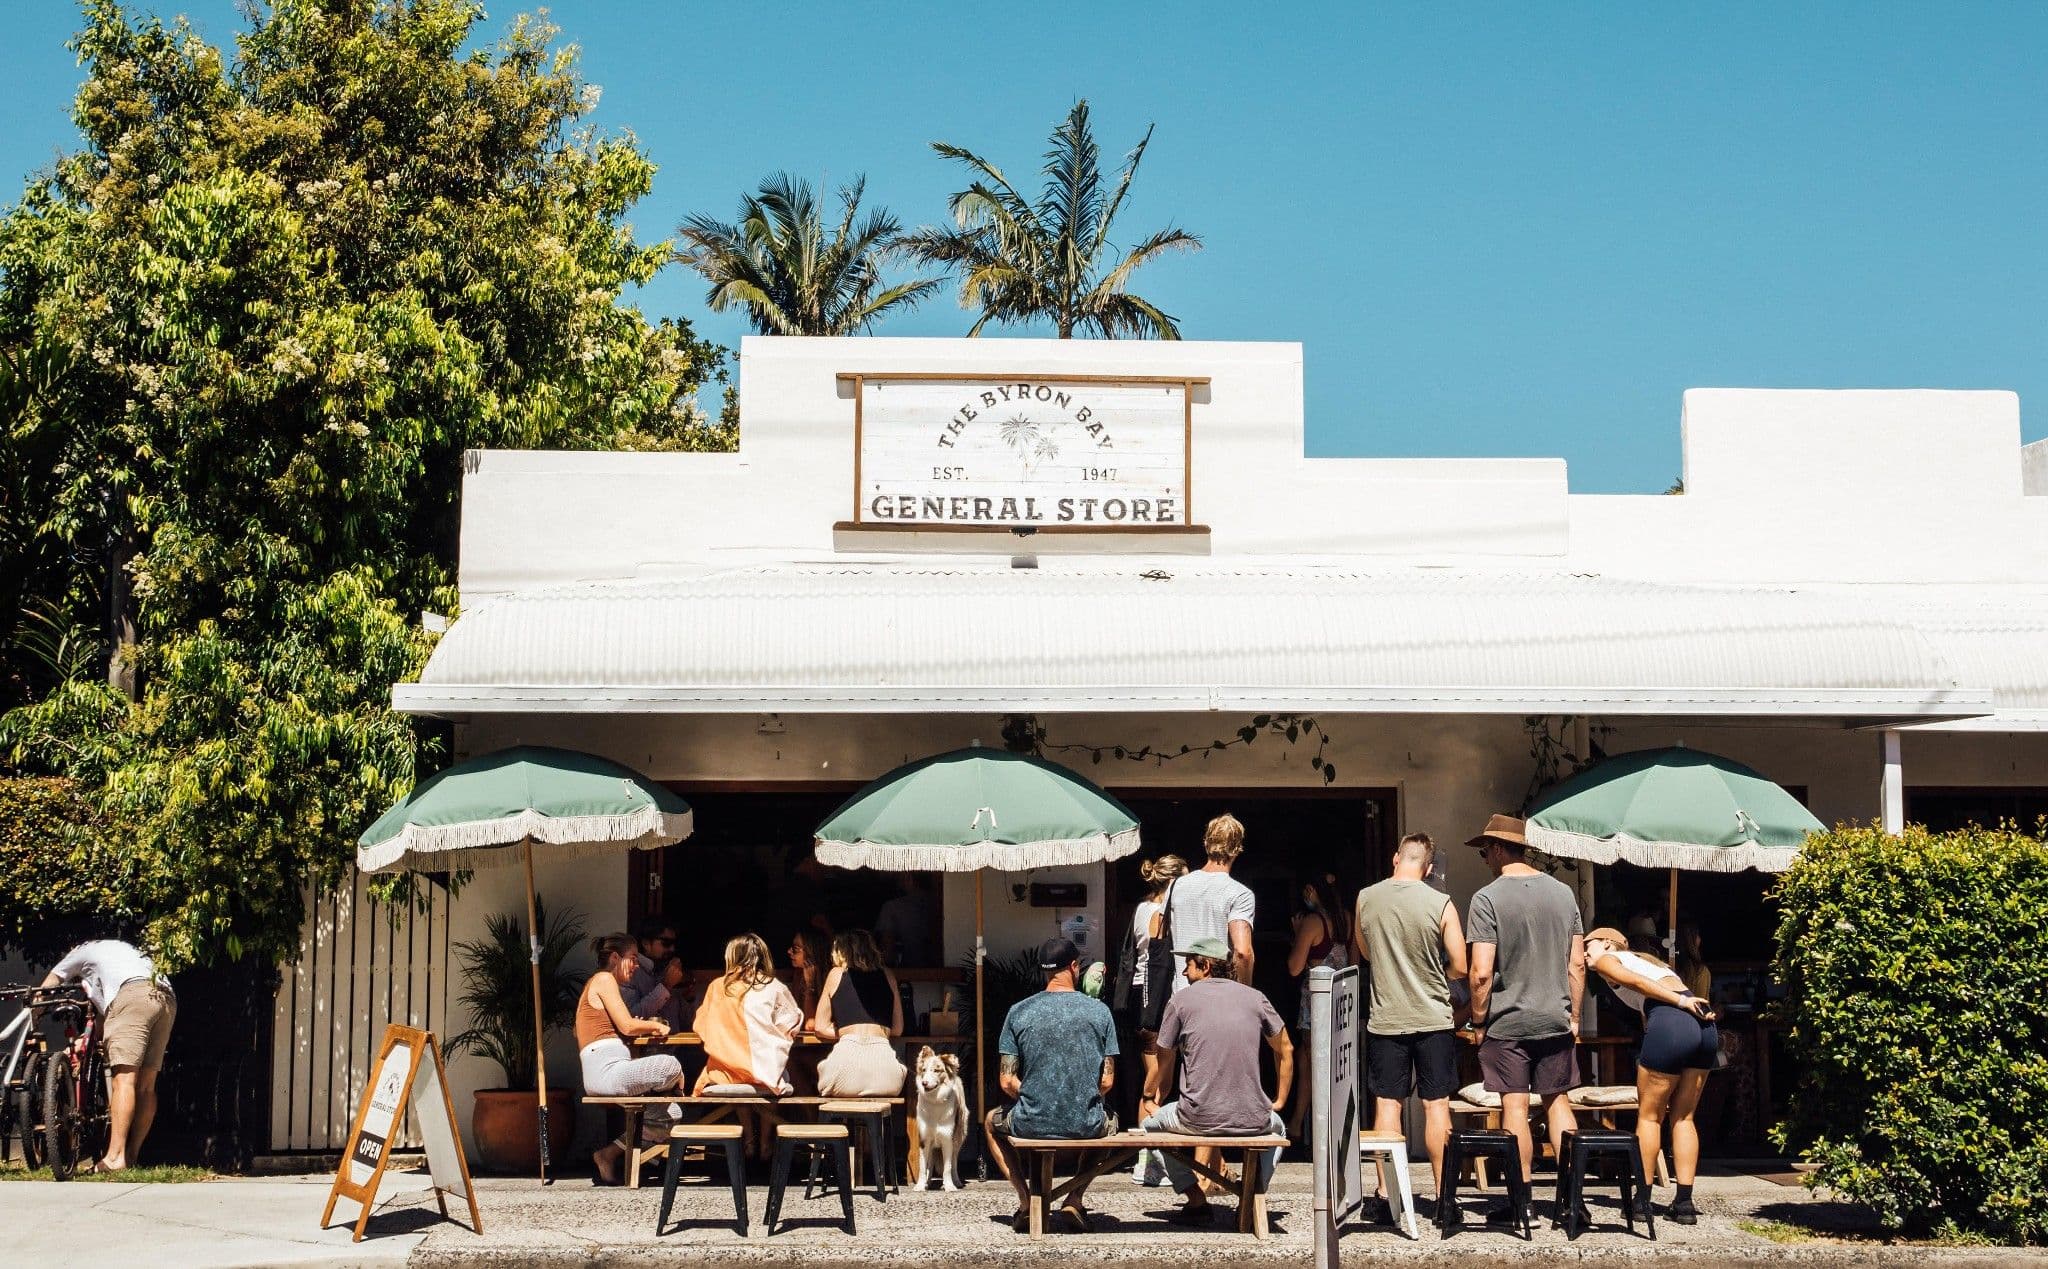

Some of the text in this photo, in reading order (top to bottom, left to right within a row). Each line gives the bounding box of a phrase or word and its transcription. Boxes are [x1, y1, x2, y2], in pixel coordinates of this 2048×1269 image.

[937, 383, 1113, 449] THE BYRON BAY
[932, 466, 1117, 481] EST. 1947
[871, 495, 1175, 522] GENERAL STORE
[1335, 993, 1353, 1031] KEEP
[1335, 1042, 1352, 1083] LEFT
[360, 1138, 382, 1160] OPEN
